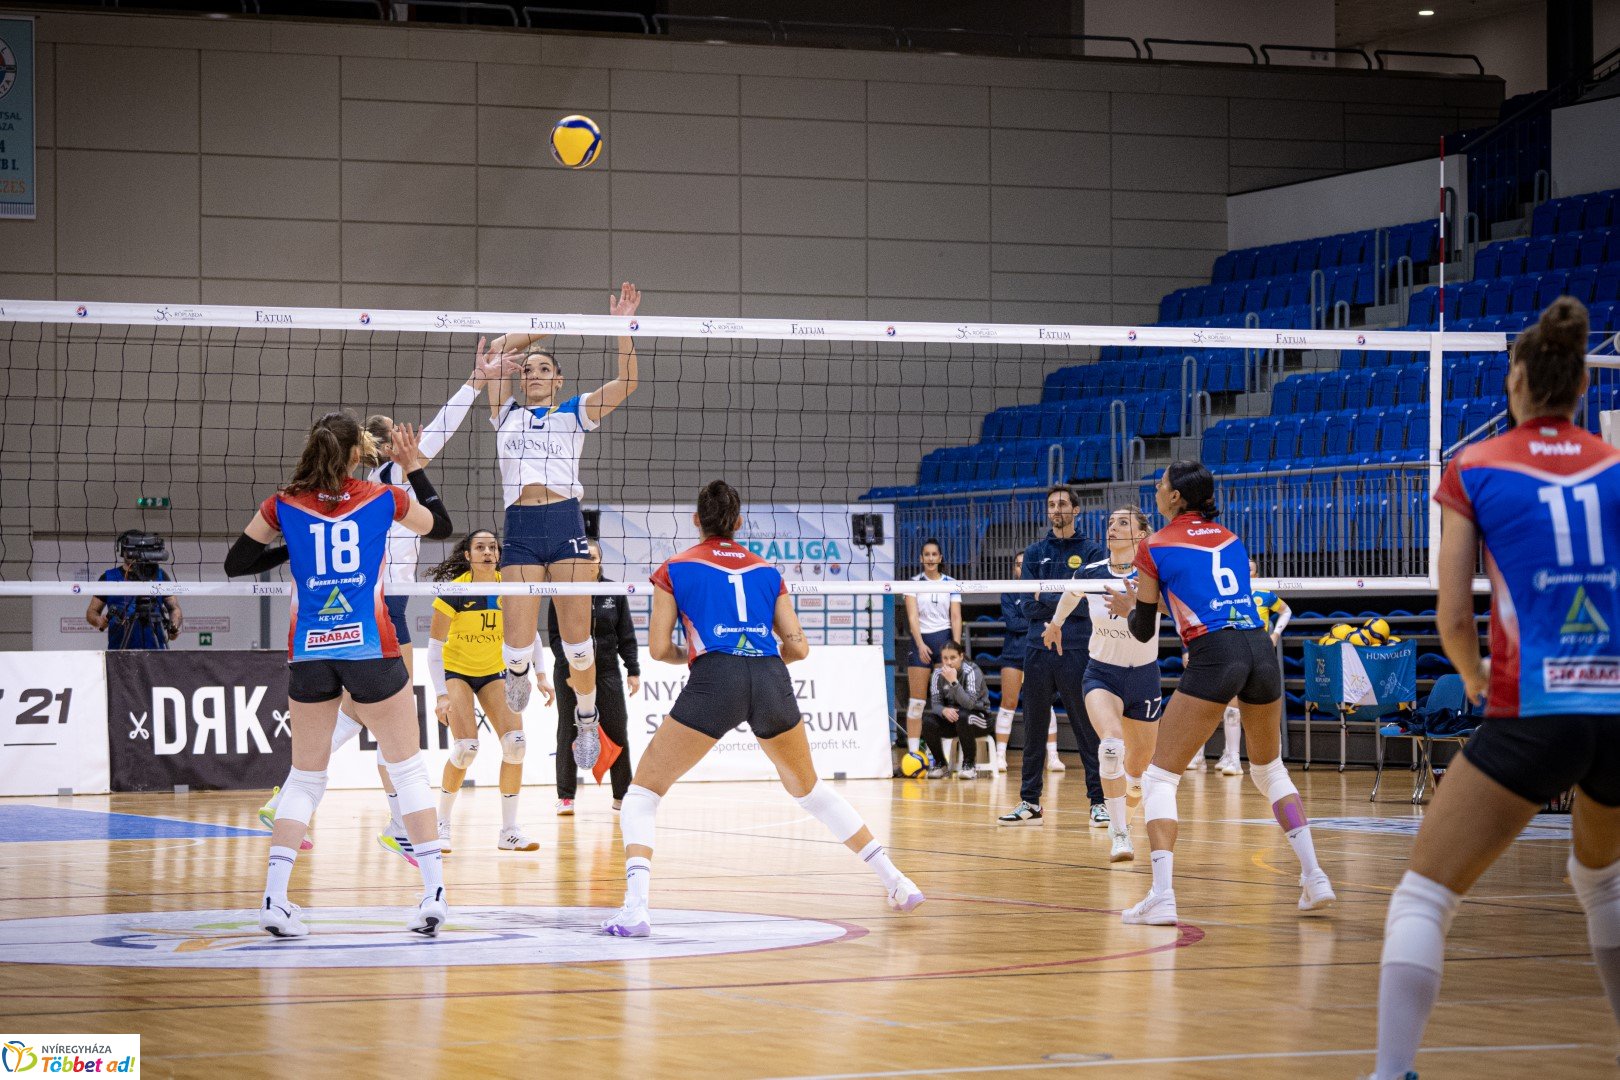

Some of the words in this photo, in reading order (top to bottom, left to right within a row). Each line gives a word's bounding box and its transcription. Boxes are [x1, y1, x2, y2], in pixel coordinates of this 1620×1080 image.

[1538, 483, 1605, 566] 11
[309, 520, 360, 575] 18
[712, 549, 746, 559] Kump
[738, 541, 841, 560] RALIGA
[1211, 551, 1240, 596] 6
[728, 573, 748, 623] 1
[480, 612, 497, 632] 14
[308, 630, 361, 644] STRABAG
[1366, 649, 1412, 660] HUNVOLLEY
[842, 739, 861, 750] Kft.
